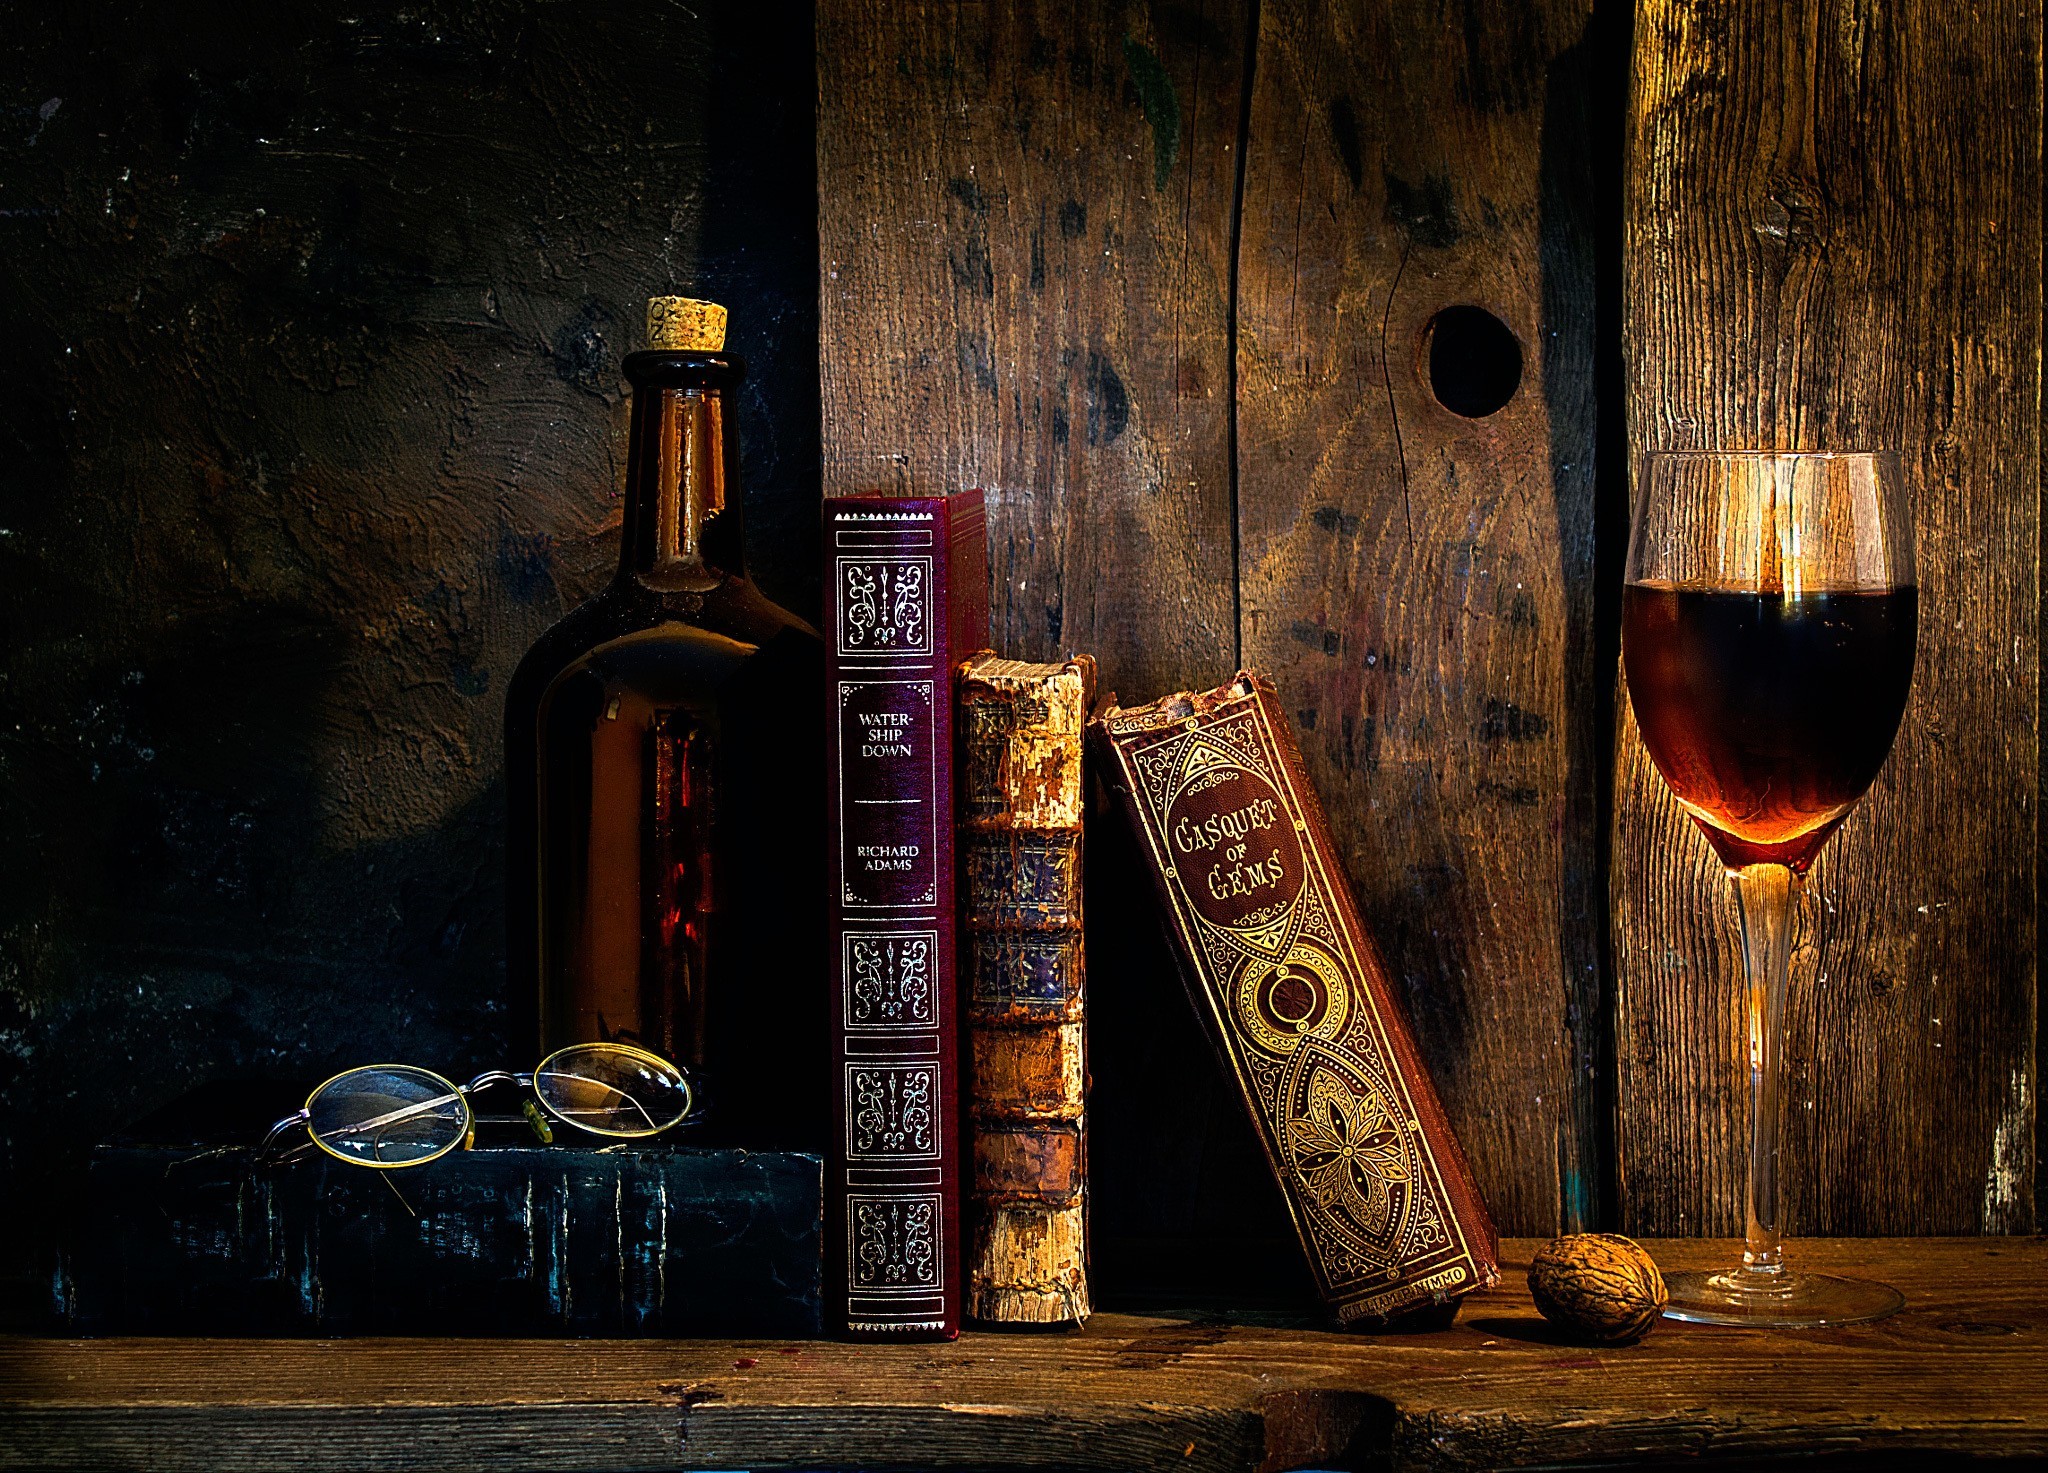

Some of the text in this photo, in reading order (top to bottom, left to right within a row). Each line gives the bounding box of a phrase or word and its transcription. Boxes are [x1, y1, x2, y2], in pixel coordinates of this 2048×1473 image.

[858, 713, 914, 726] WATER-
[868, 729, 903, 742] SHIP
[862, 744, 912, 757] DOWN
[1175, 798, 1277, 853] CASQUET
[857, 845, 919, 857] RICHARD
[1226, 843, 1247, 862] OF
[864, 859, 912, 871] ADAMS
[1208, 848, 1284, 900] GEMS
[1340, 1292, 1397, 1319] WILLIAM
[1414, 1269, 1463, 1294] NIMMO
